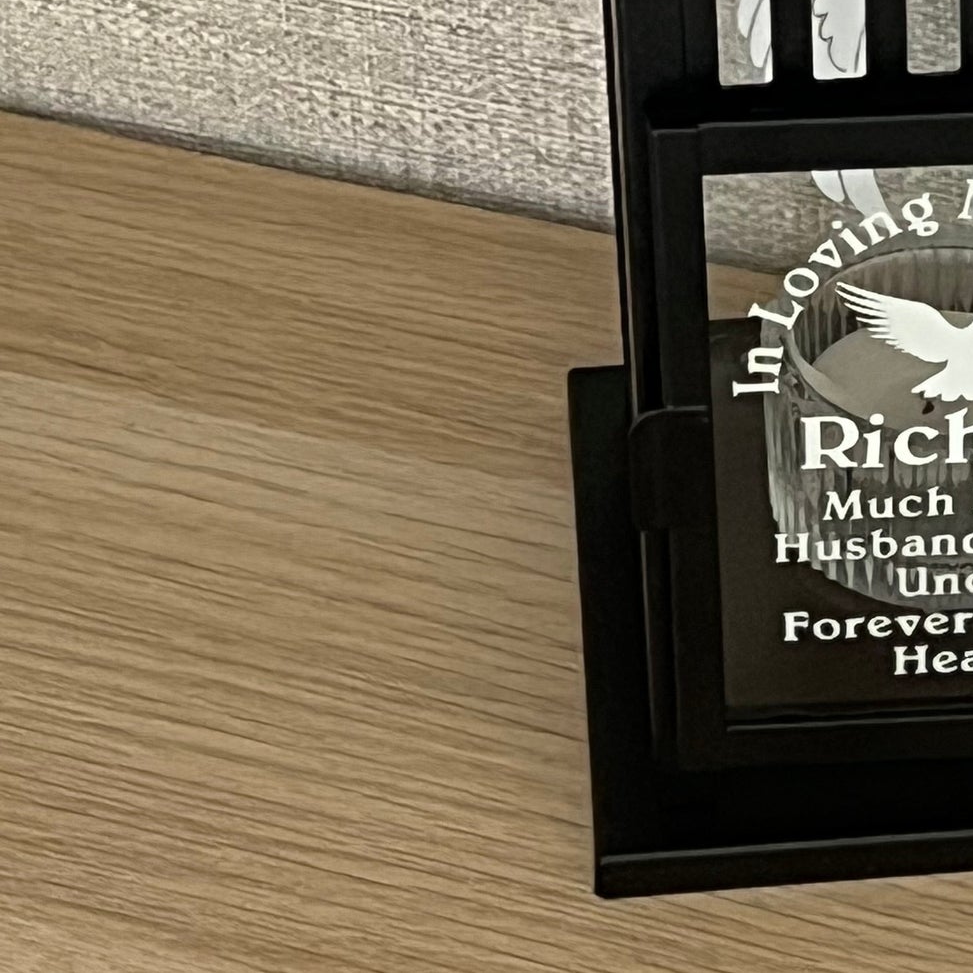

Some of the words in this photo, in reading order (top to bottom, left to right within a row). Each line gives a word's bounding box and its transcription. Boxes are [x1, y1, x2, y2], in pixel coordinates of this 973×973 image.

[747, 192, 939, 330] Loving
[732, 345, 784, 397] In
[822, 486, 955, 521] Much
[782, 607, 973, 642] Forever
